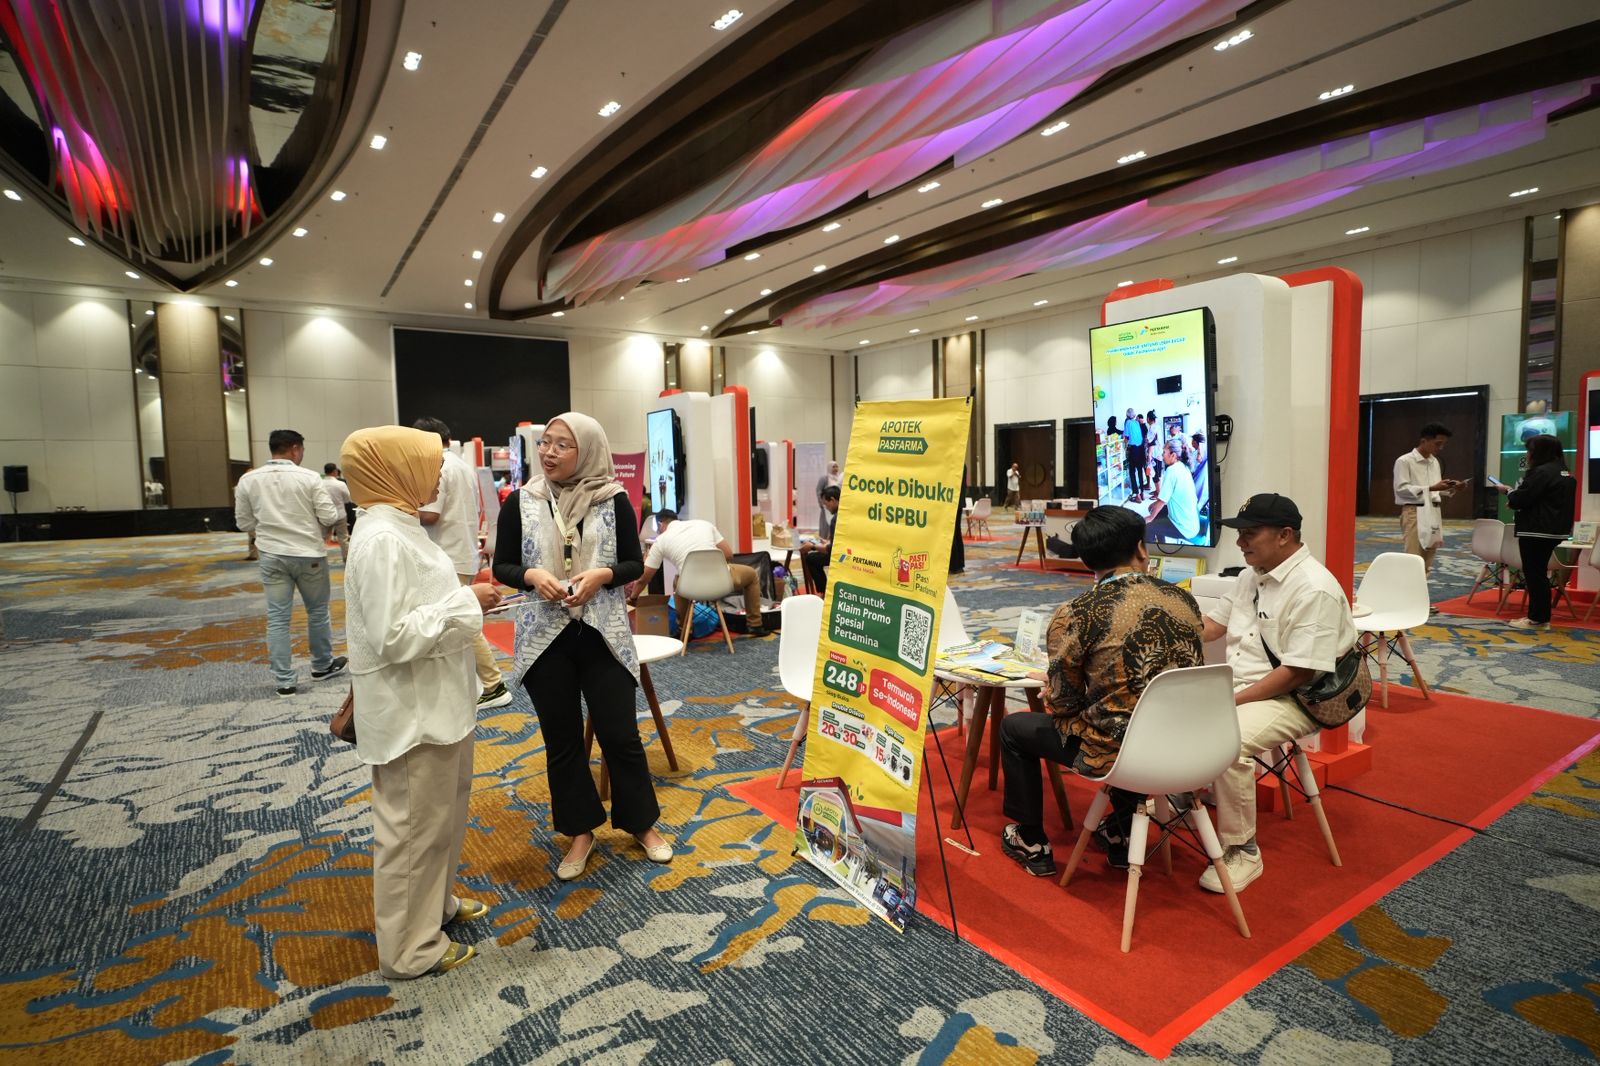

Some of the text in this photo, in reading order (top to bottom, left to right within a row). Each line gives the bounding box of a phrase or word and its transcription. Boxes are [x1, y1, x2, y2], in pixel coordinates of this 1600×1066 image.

[880, 420, 922, 434] APOTEK
[879, 439, 924, 452] PASFARMA
[848, 474, 954, 504] Cocok Dibuka
[867, 502, 928, 529] di SPBU
[852, 556, 882, 569] PERTAMINA
[909, 553, 928, 563] PASTI
[839, 588, 886, 610] Scan untuk
[835, 613, 865, 631] Spesial
[837, 600, 891, 625] Klaim Promo
[834, 625, 879, 648] Pertamina
[826, 665, 858, 691] 248
[882, 677, 915, 705] Termurah
[873, 687, 917, 721] Se-Indonesia
[821, 721, 835, 736] 20
[843, 730, 857, 745] 30
